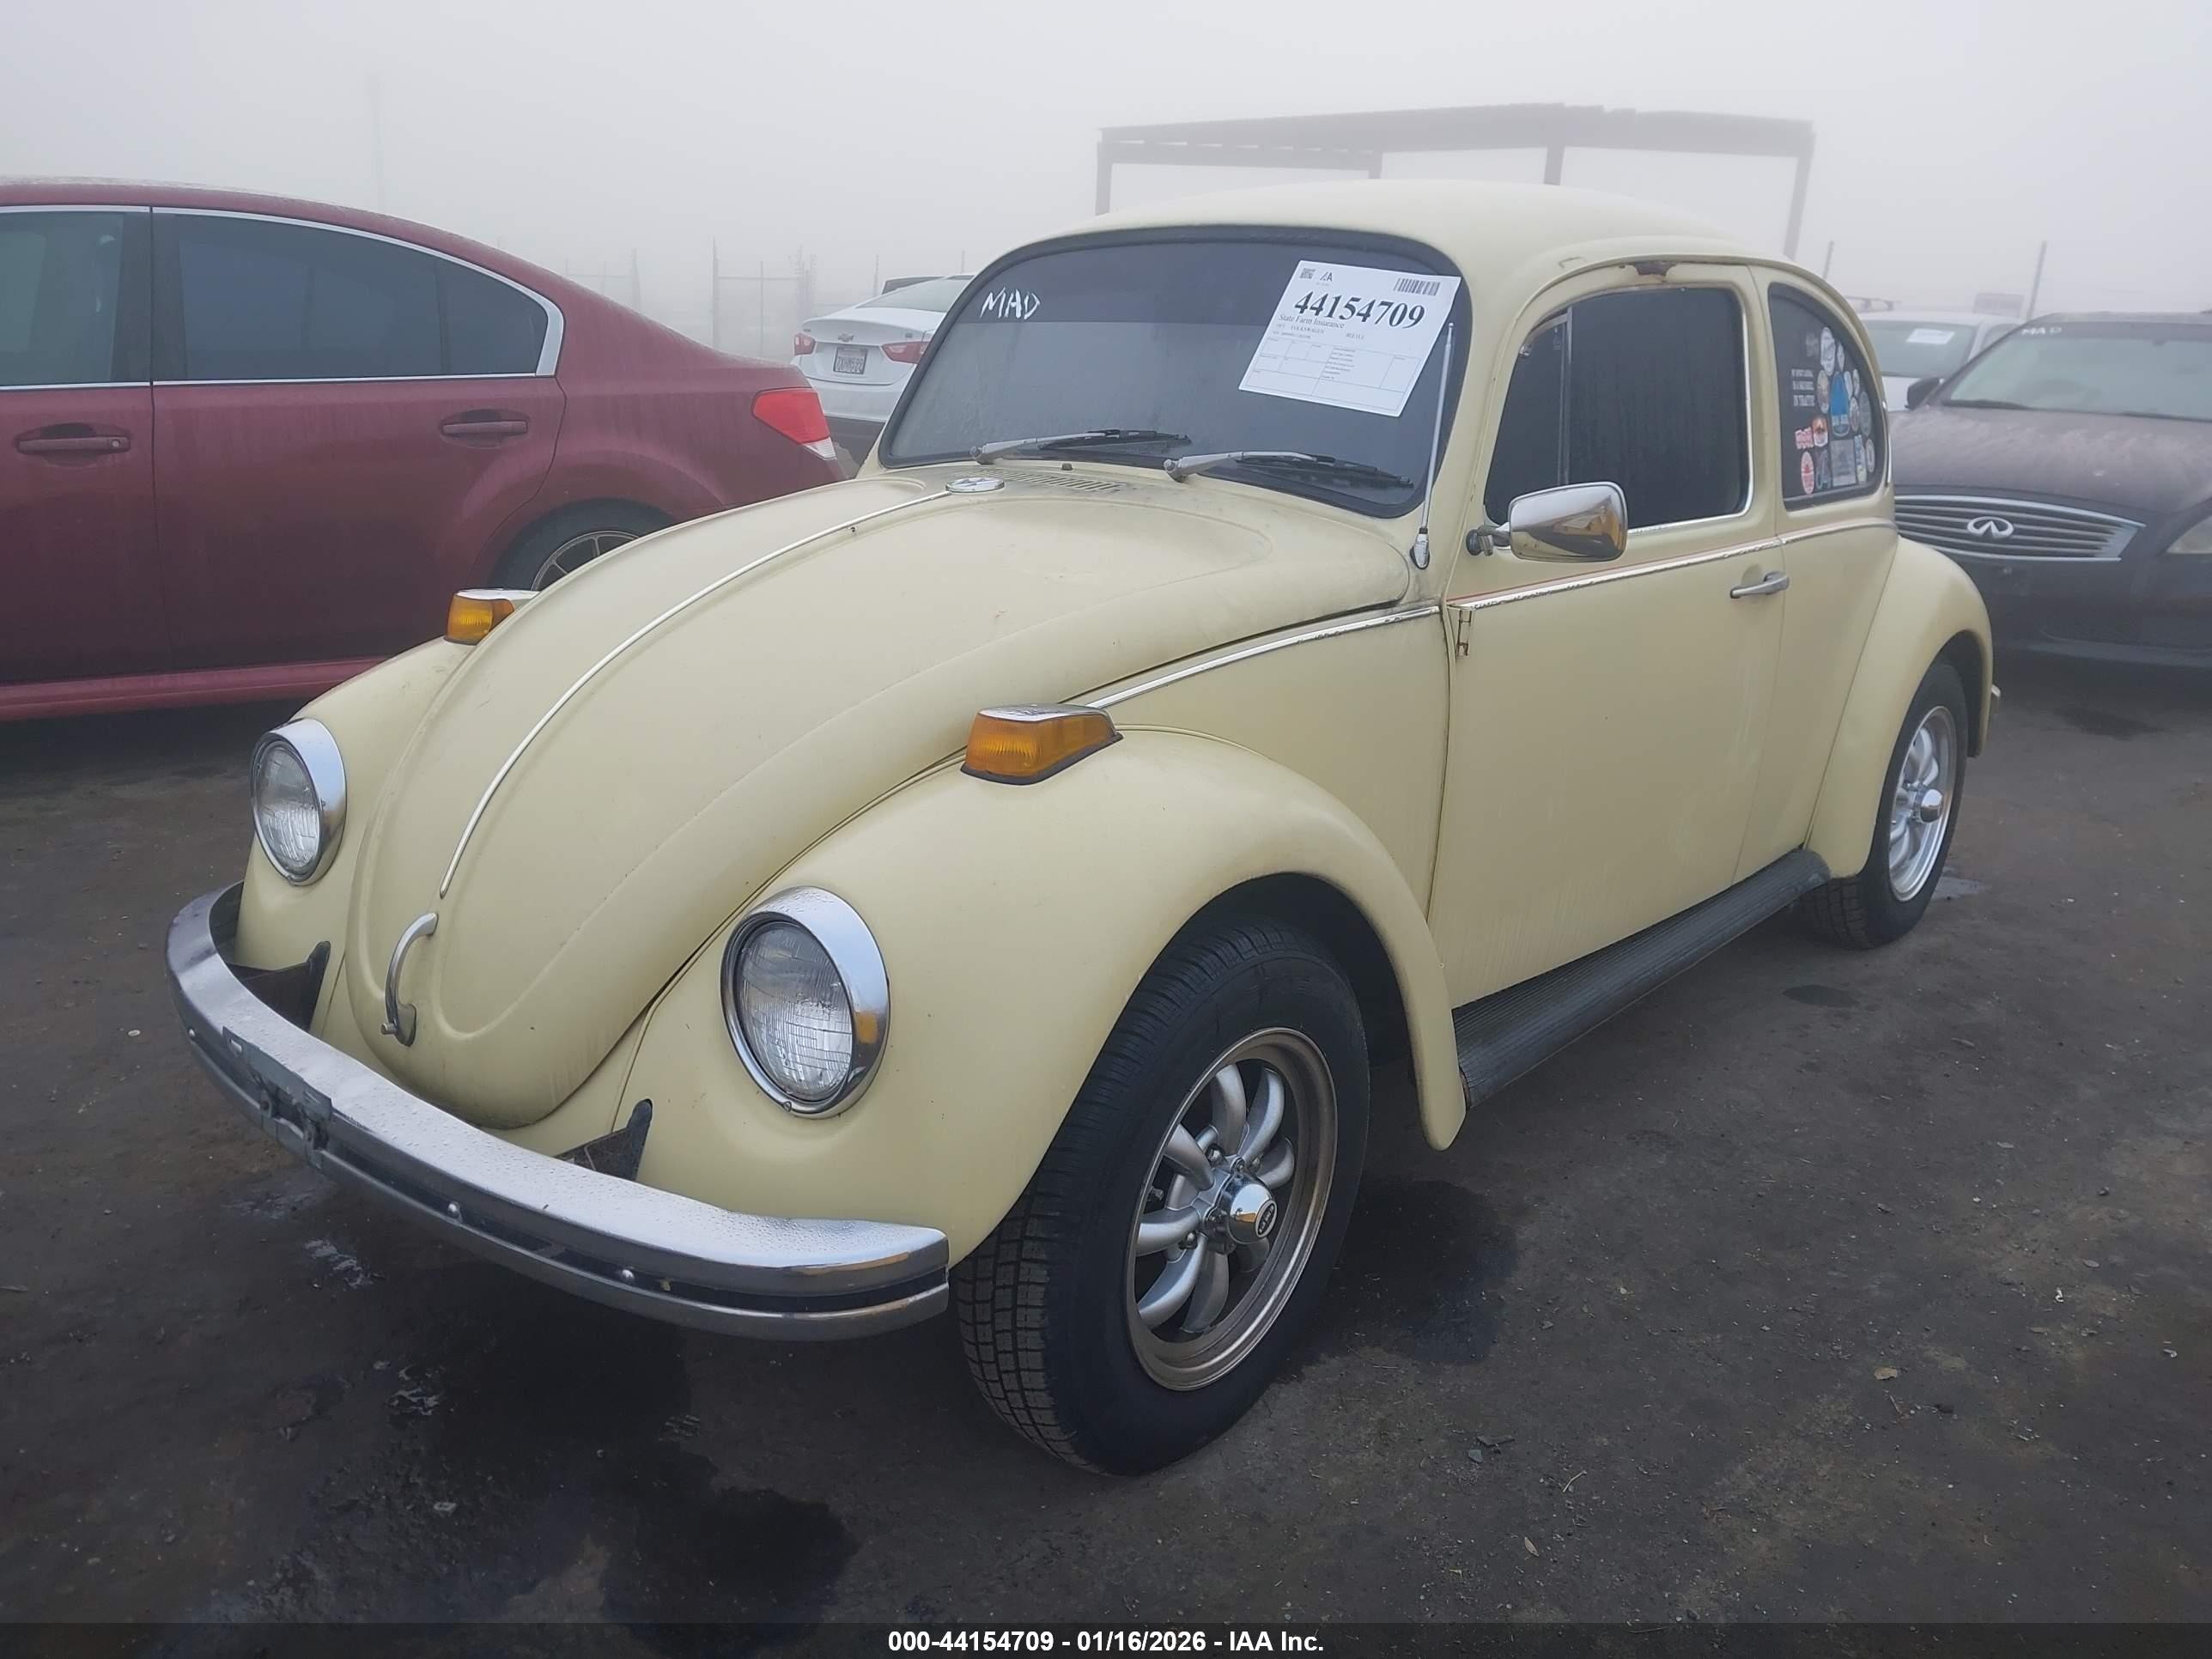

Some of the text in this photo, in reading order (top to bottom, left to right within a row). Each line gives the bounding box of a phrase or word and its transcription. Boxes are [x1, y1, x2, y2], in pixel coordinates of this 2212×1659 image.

[979, 286, 1041, 320] MAD
[1294, 290, 1425, 330] 44154709
[1279, 314, 1346, 329] State Farm Insurance
